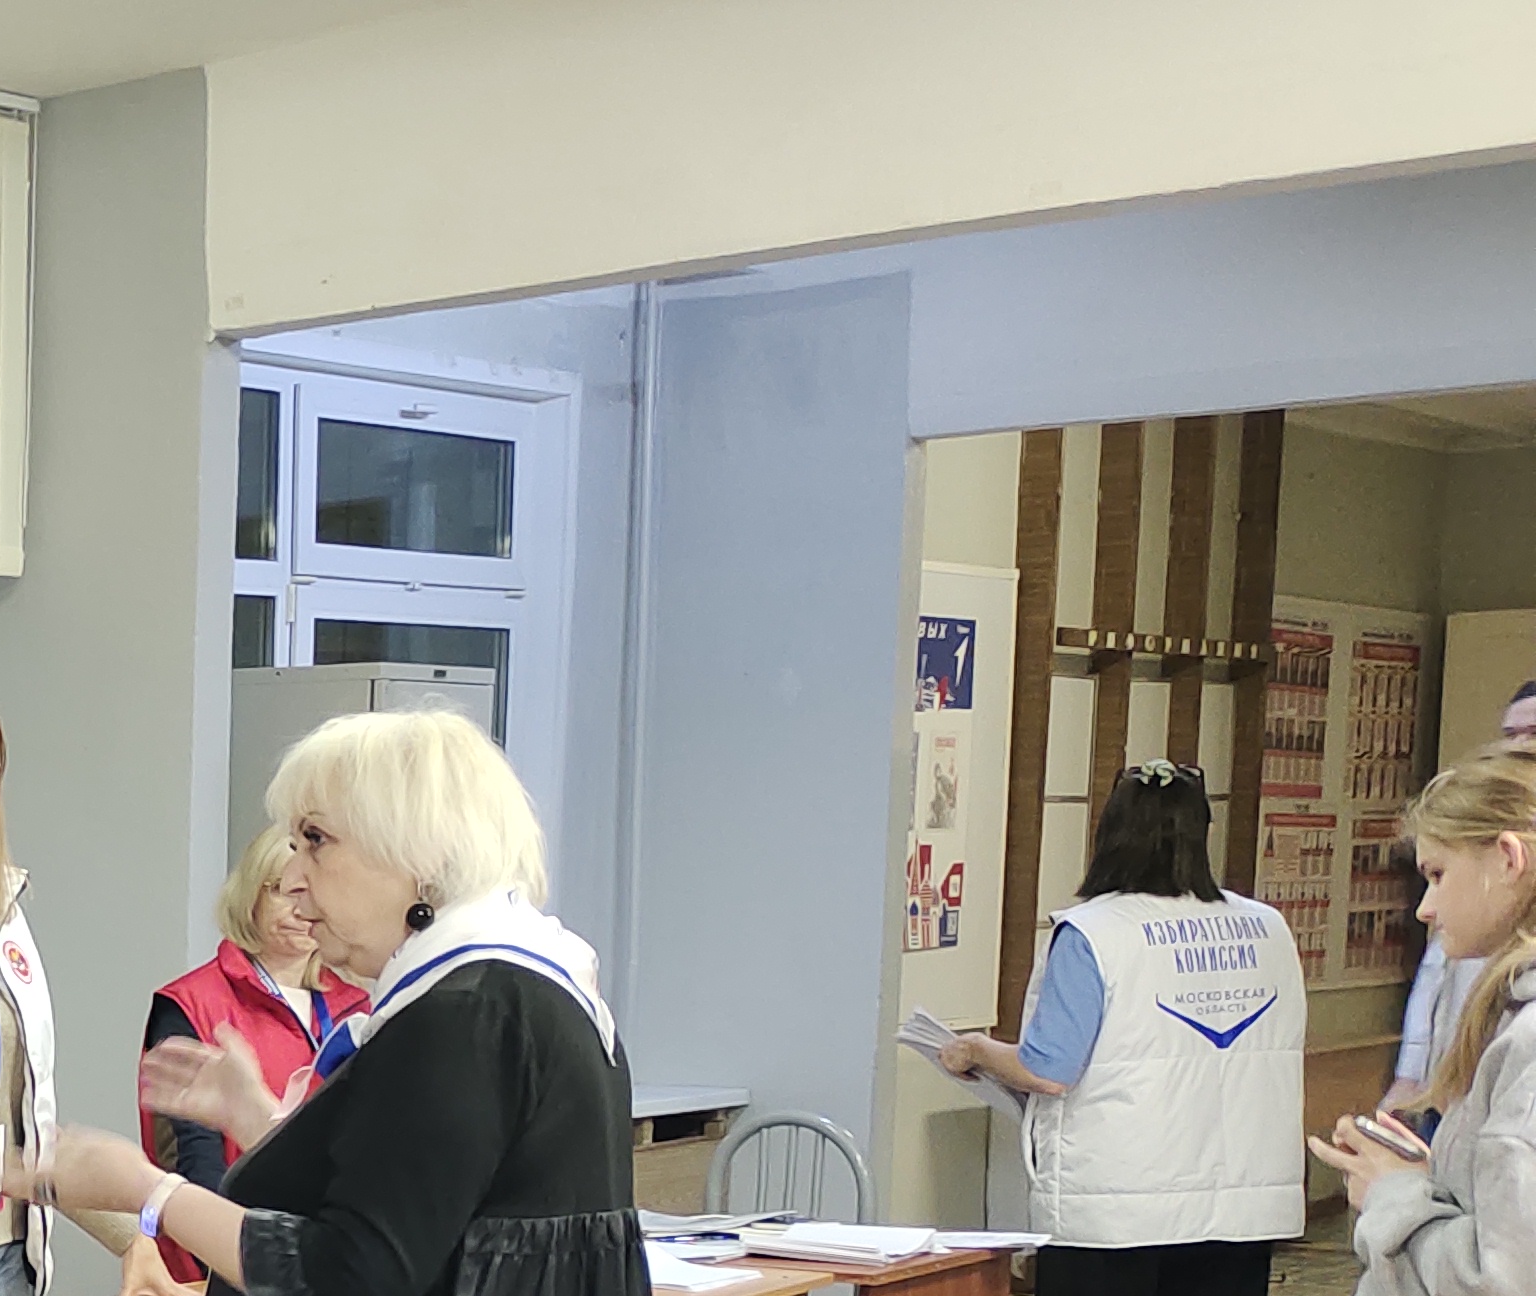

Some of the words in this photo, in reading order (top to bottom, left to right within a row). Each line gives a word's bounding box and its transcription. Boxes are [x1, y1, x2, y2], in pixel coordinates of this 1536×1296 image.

[1141, 915, 1269, 947] ИЗБИРАТЕЛЬНАЯ
[1174, 943, 1258, 974] КОМИССИЯ
[1174, 987, 1267, 1005] МОСКОВСКАЯ
